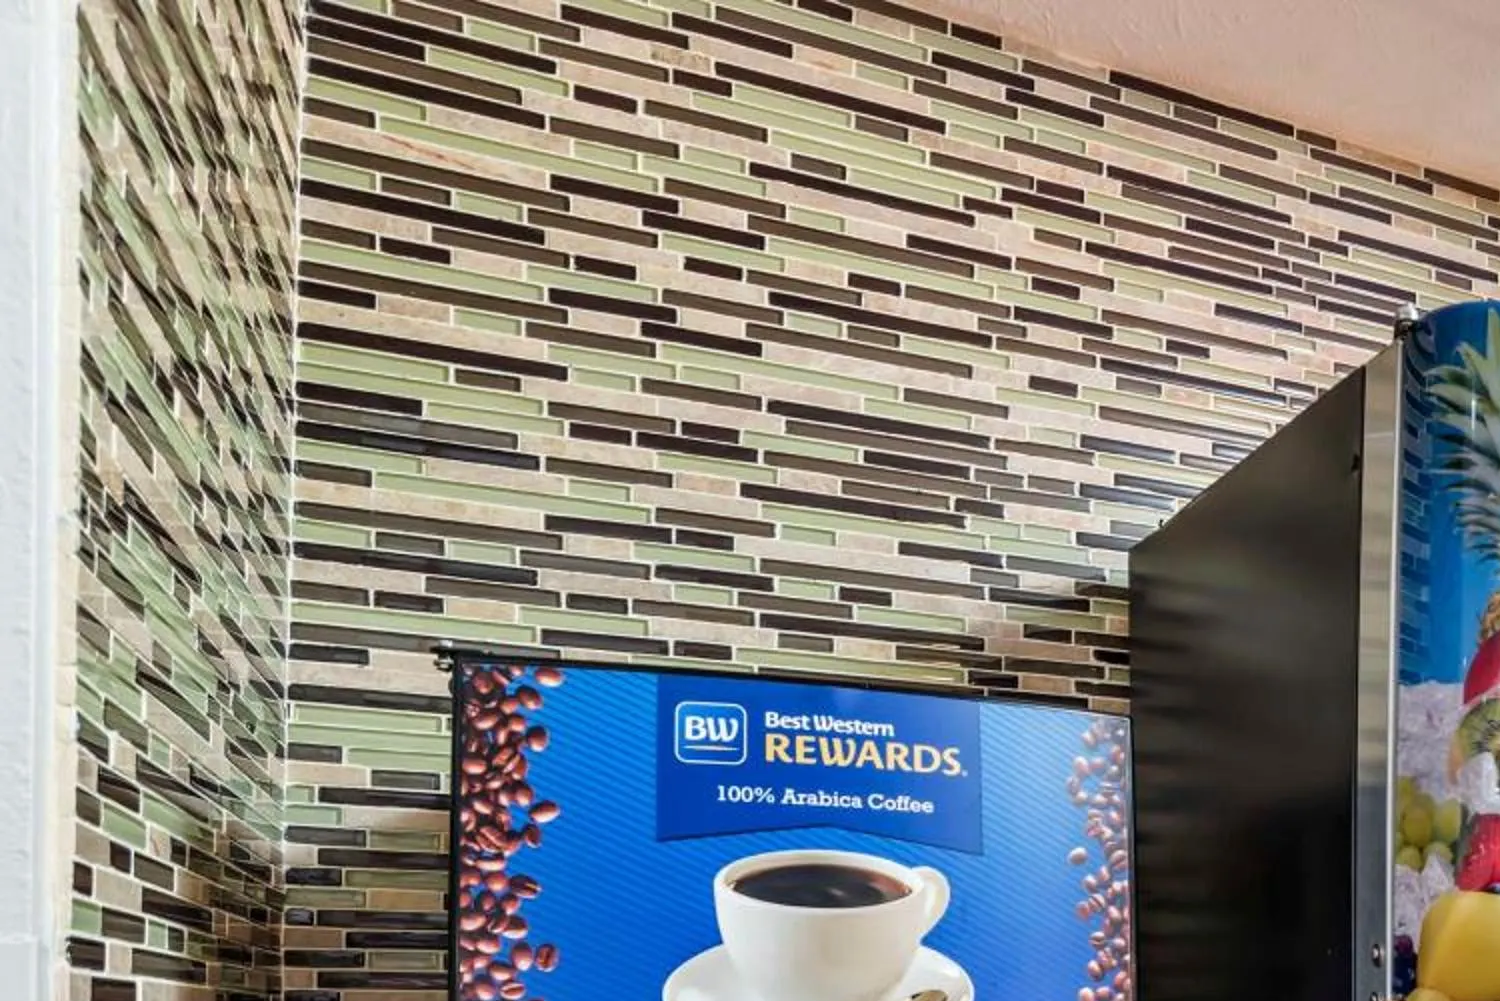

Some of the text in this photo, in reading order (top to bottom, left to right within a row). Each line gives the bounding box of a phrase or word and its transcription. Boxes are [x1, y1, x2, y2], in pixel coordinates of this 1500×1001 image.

[684, 714, 740, 743] BW
[764, 711, 895, 737] Best Western
[716, 784, 935, 814] 100% Arabica Coffee
